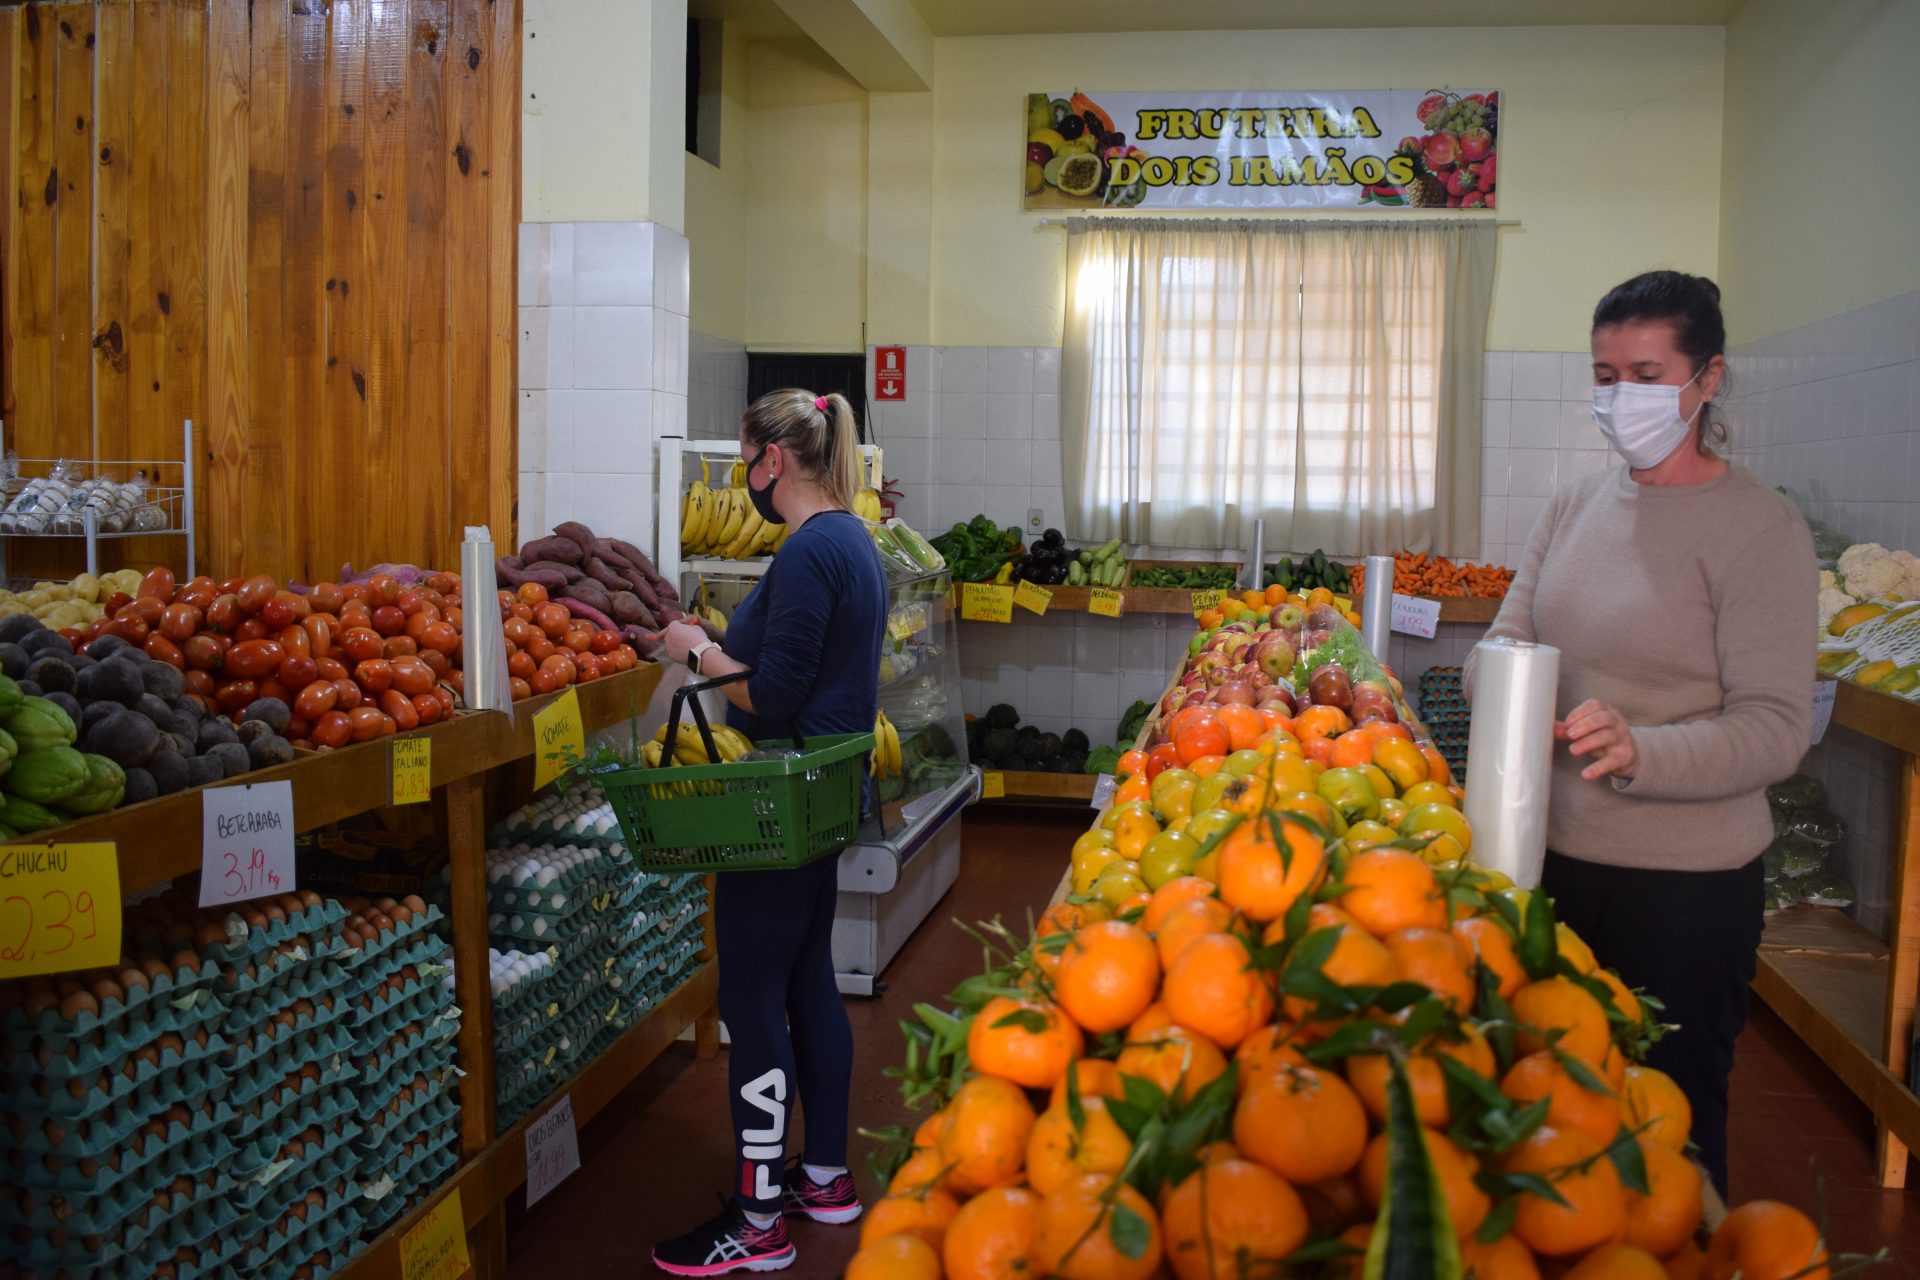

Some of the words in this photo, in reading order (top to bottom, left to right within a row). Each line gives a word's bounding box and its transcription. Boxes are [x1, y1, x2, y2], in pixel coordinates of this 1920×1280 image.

[1136, 107, 1382, 140] FRUTEIRA
[1108, 156, 1220, 187] DOIS
[1228, 147, 1415, 187] IRMÃOS
[542, 715, 572, 745] TOMATE
[395, 739, 422, 753] TOMATE
[395, 756, 427, 768] ITALIANO
[218, 811, 281, 838] BETERRABA
[0, 849, 67, 878] CHUCHU
[223, 847, 265, 896] 3,19
[0, 889, 96, 961] 2,39
[740, 1067, 787, 1200] FILA
